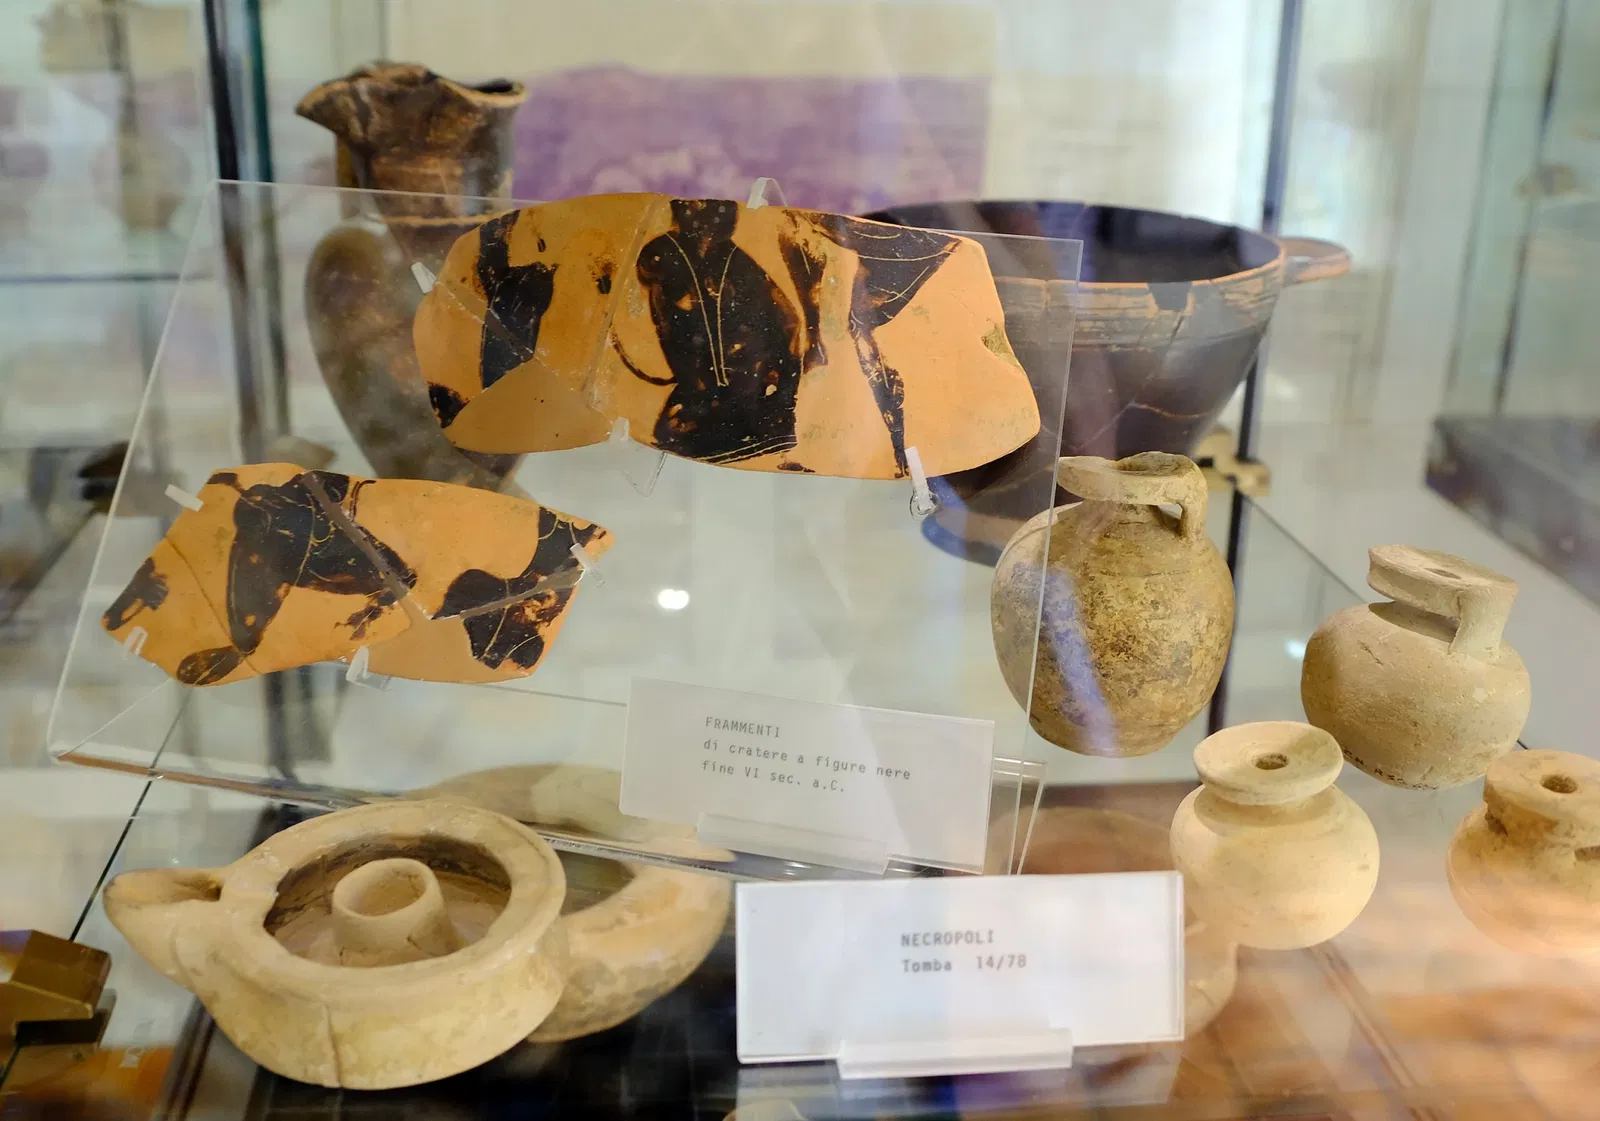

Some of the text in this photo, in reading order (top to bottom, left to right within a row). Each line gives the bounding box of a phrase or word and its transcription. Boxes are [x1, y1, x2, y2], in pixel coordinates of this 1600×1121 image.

[705, 716, 781, 738] FRAMMENTI
[703, 740, 911, 780] di cratere a figure nere
[702, 760, 844, 792] fine VI sec. a.C.
[900, 929, 995, 947] NECROPOLI
[902, 954, 1028, 973] Tomba 14/78
